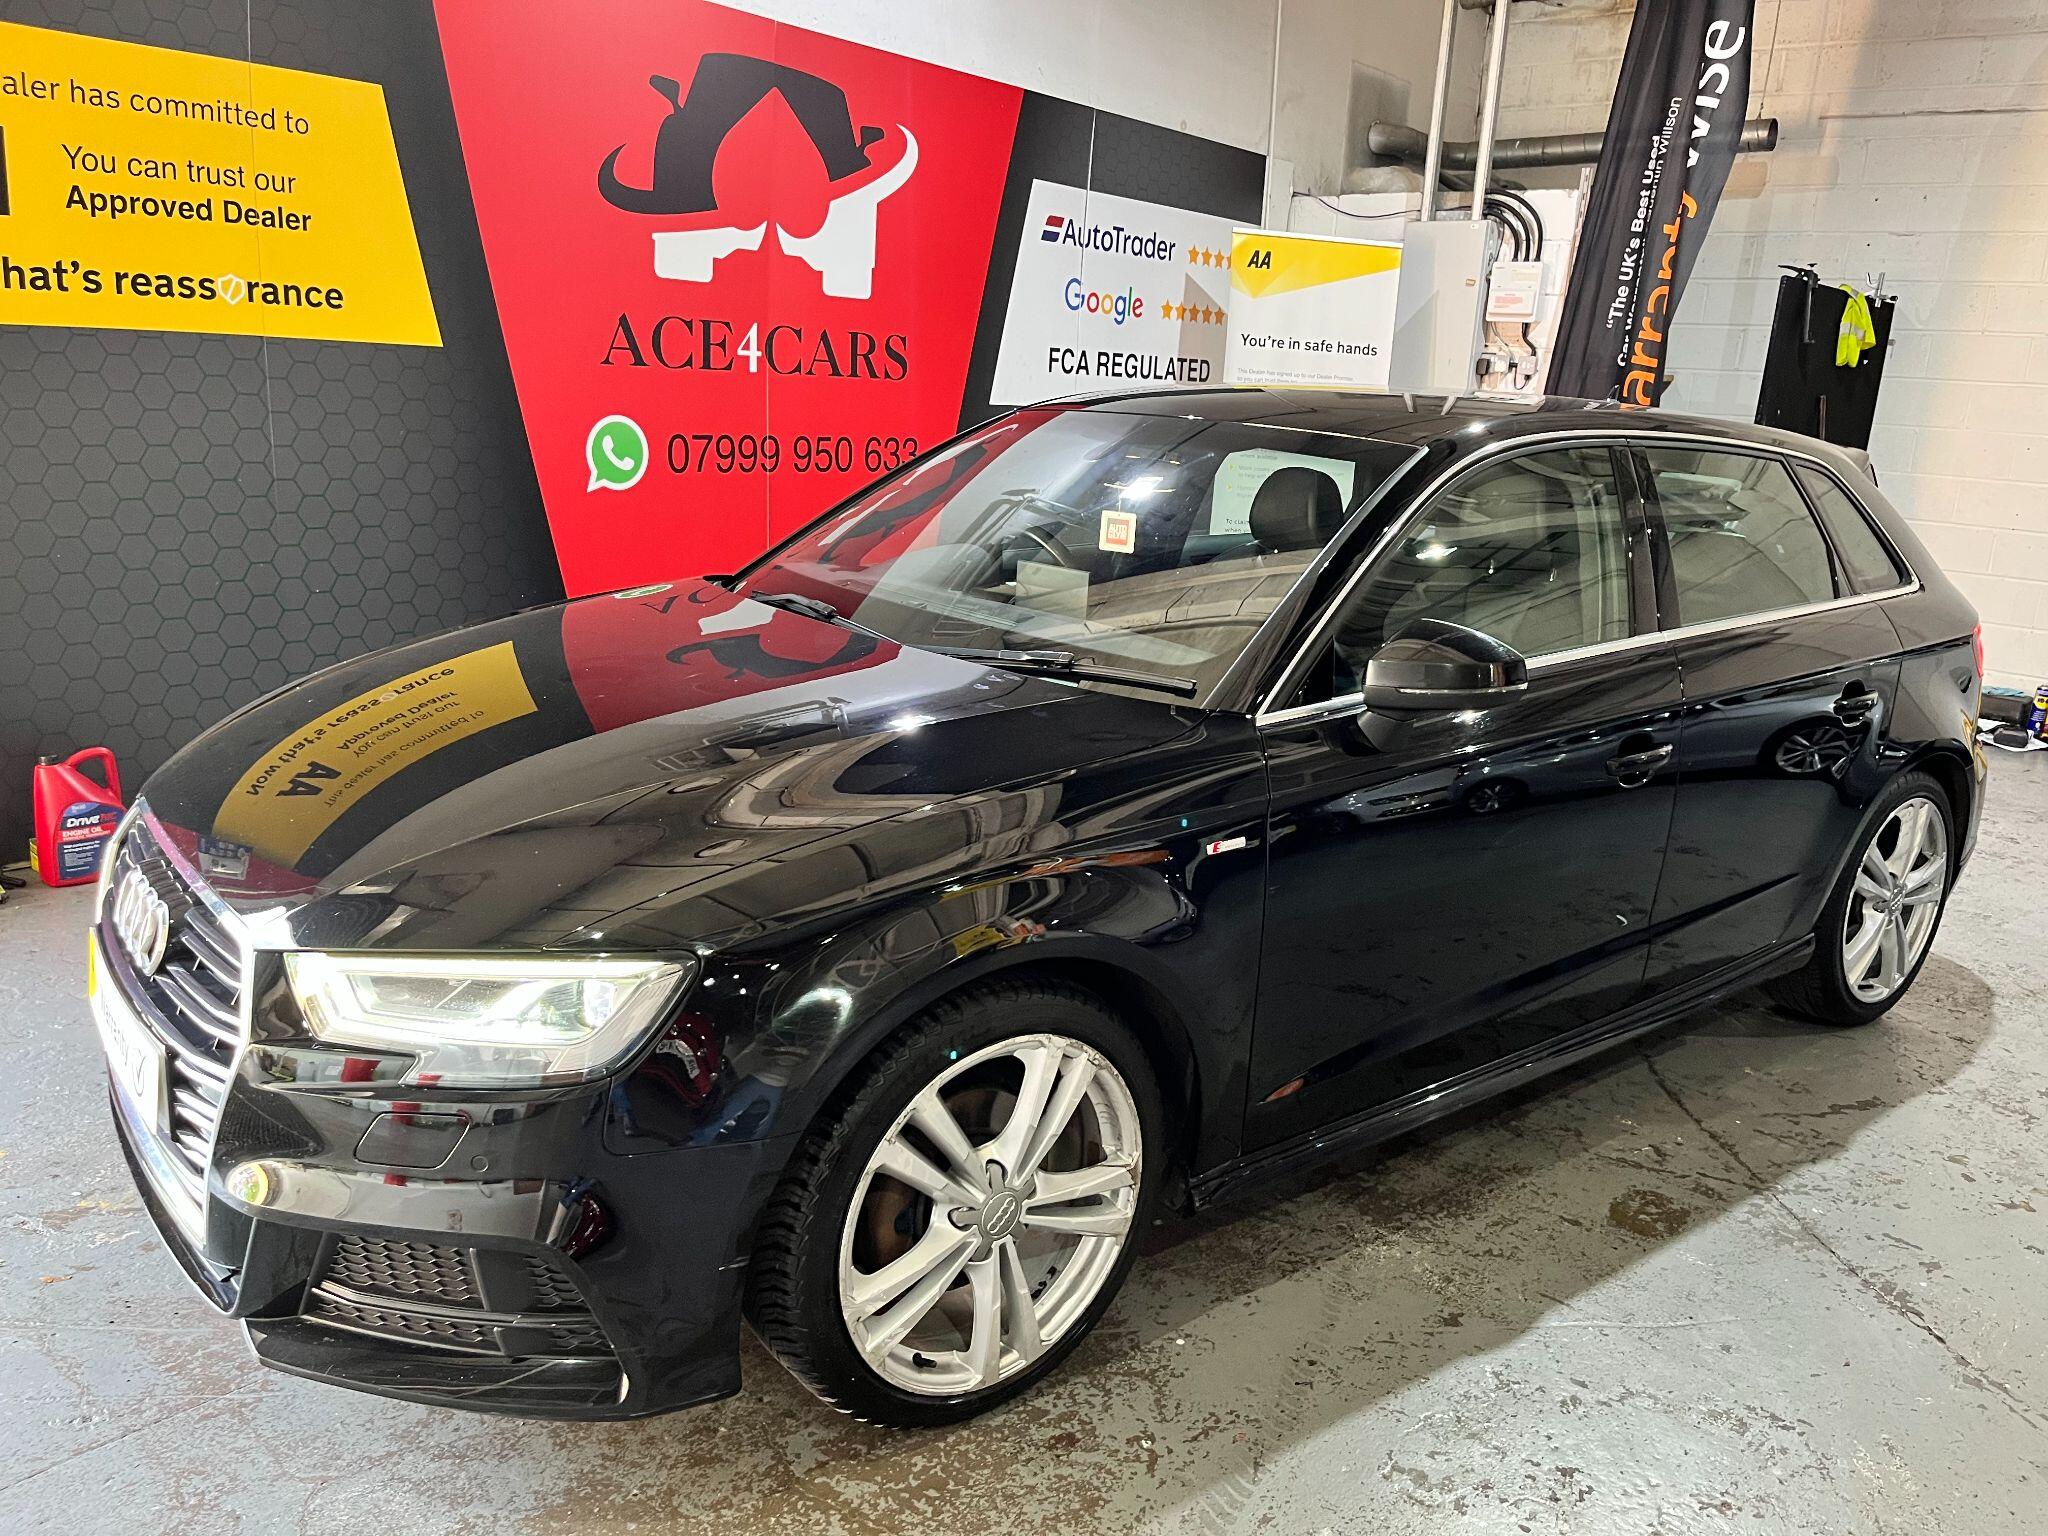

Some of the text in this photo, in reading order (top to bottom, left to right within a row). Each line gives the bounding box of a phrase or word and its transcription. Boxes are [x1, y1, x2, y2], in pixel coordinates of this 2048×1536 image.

[2, 71, 309, 135] aler has committed to
[1658, 97, 1682, 155] Willson
[62, 143, 297, 194] You can trust our
[66, 184, 312, 232] Approved Dealer
[1618, 237, 1641, 281] UK’s
[1630, 189, 1651, 233] Best
[1641, 135, 1660, 184] Used
[1062, 216, 1176, 262] AutoTrader
[1246, 249, 1272, 270] AA
[2, 255, 103, 295] hat’s
[1064, 277, 1145, 326] Google
[600, 312, 908, 381] ACE4CARS
[1048, 346, 1211, 383] FCA REGULATED
[1240, 333, 1378, 357] You’re in safe hands
[667, 433, 918, 474] 07999 950 633
